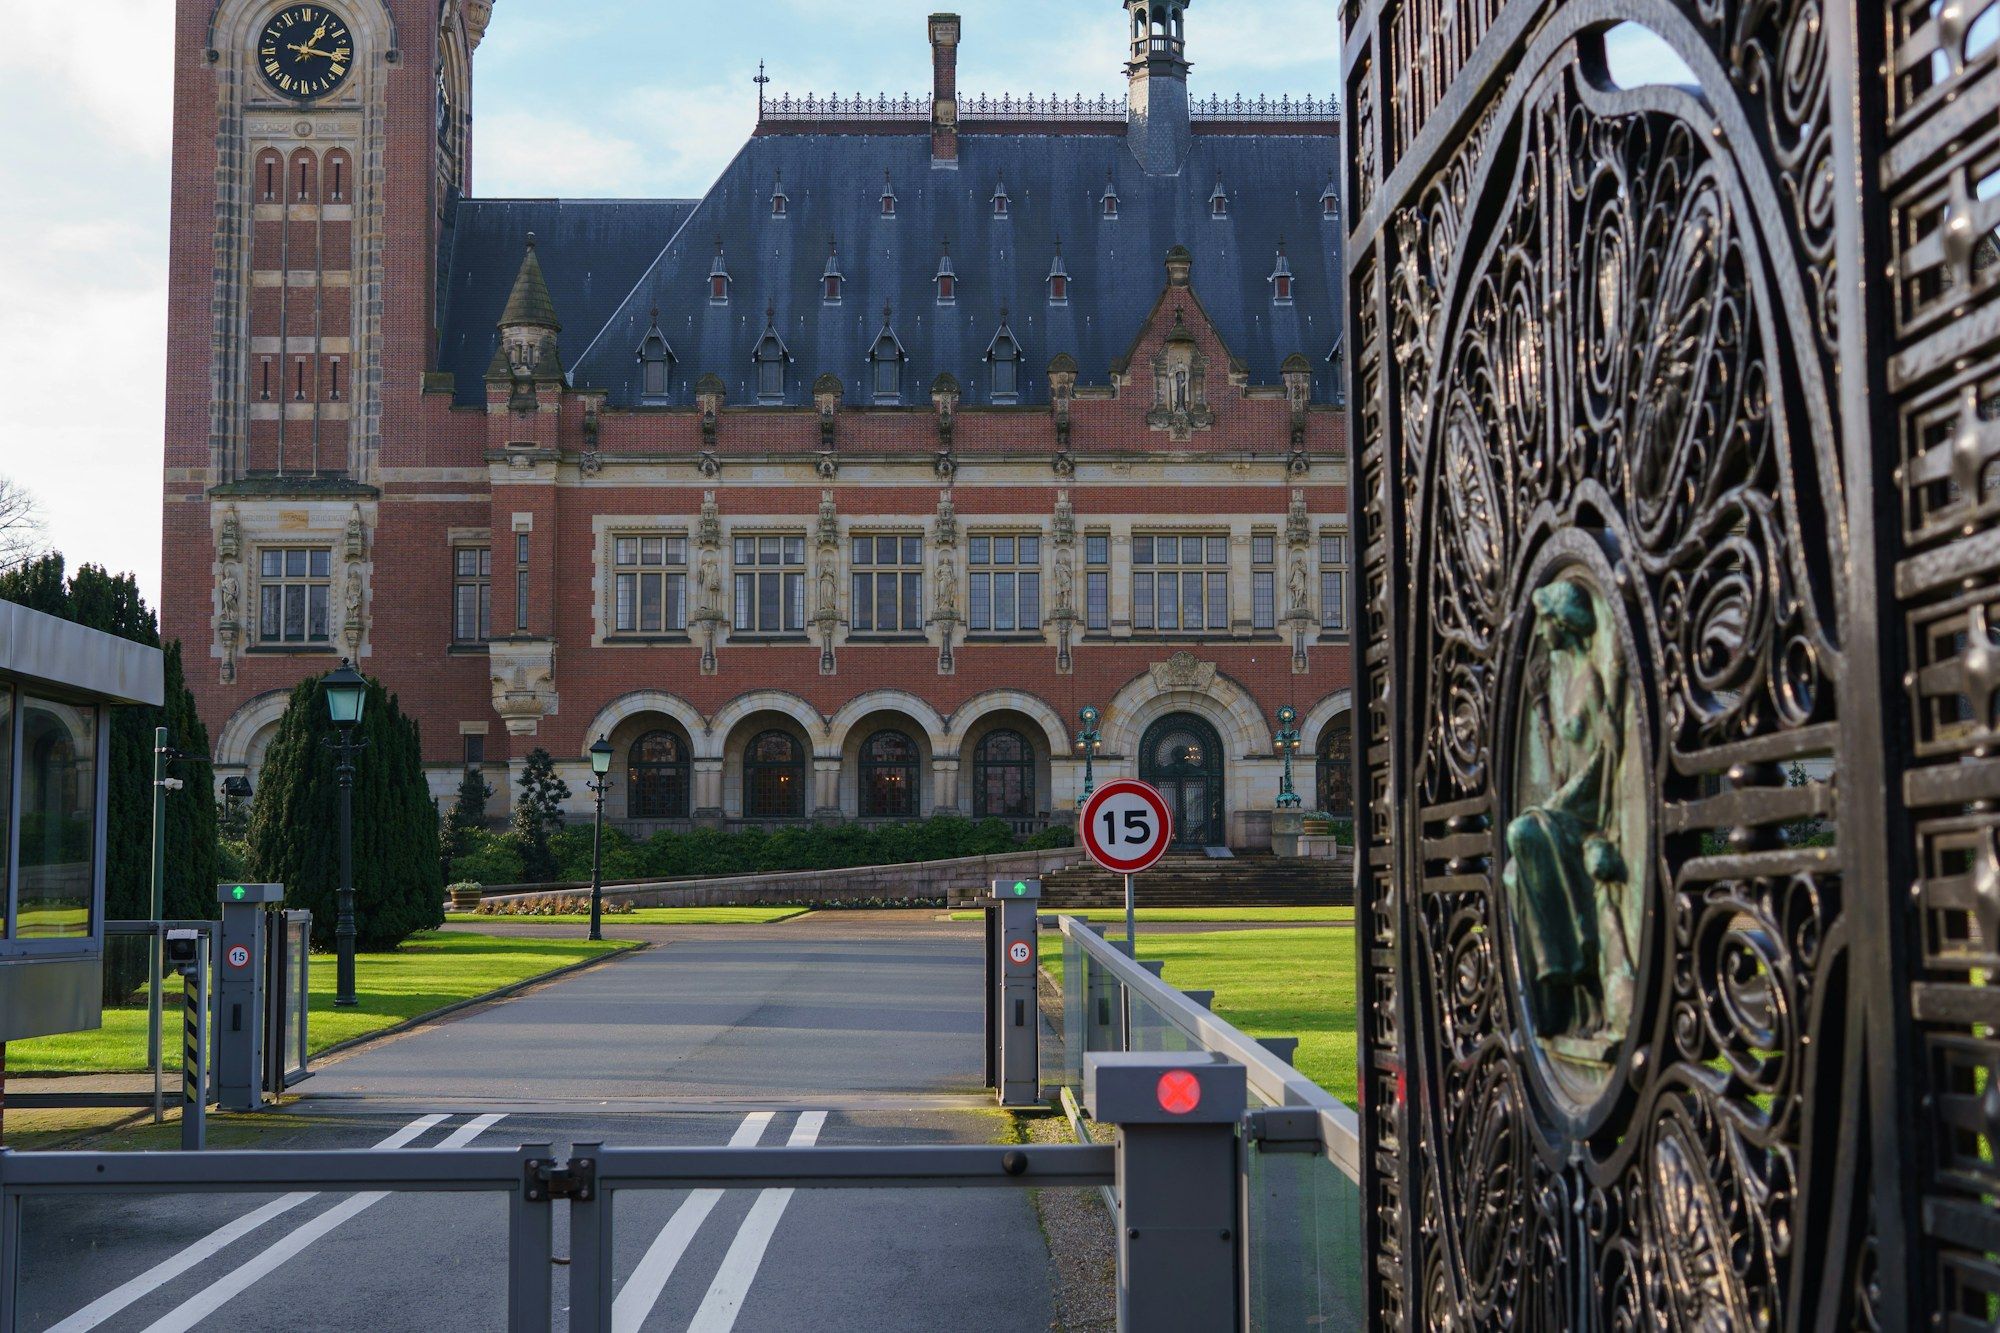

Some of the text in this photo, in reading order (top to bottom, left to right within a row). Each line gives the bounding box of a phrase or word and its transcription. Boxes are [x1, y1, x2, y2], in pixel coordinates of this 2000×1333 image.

[1103, 810, 1151, 845] 15
[232, 951, 245, 962] 15
[1013, 948, 1027, 958] 15
